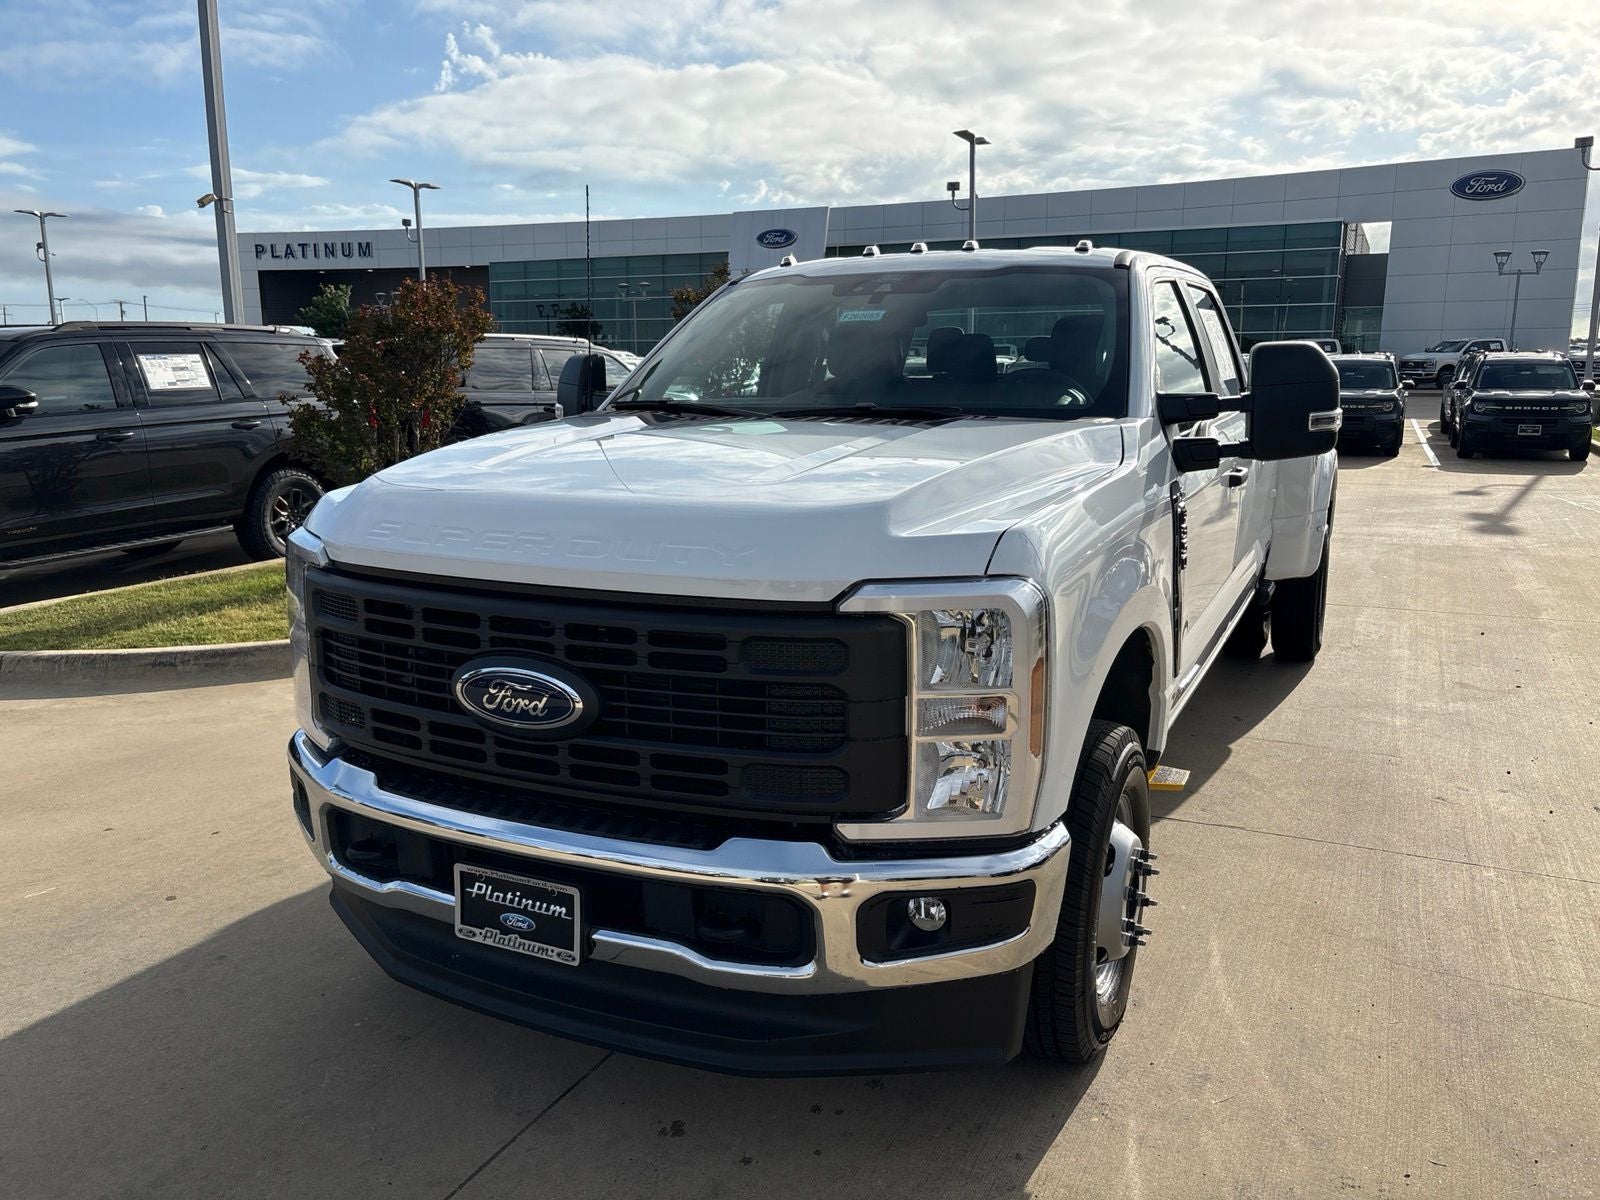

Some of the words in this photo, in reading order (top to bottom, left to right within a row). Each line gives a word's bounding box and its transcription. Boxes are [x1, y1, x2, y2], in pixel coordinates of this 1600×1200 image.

[1465, 176, 1508, 194] Ford
[254, 241, 374, 260] PLATINUM
[366, 519, 555, 556] SUPER
[567, 536, 759, 568] DUTY
[482, 680, 550, 717] Ford
[465, 882, 573, 920] Platinum
